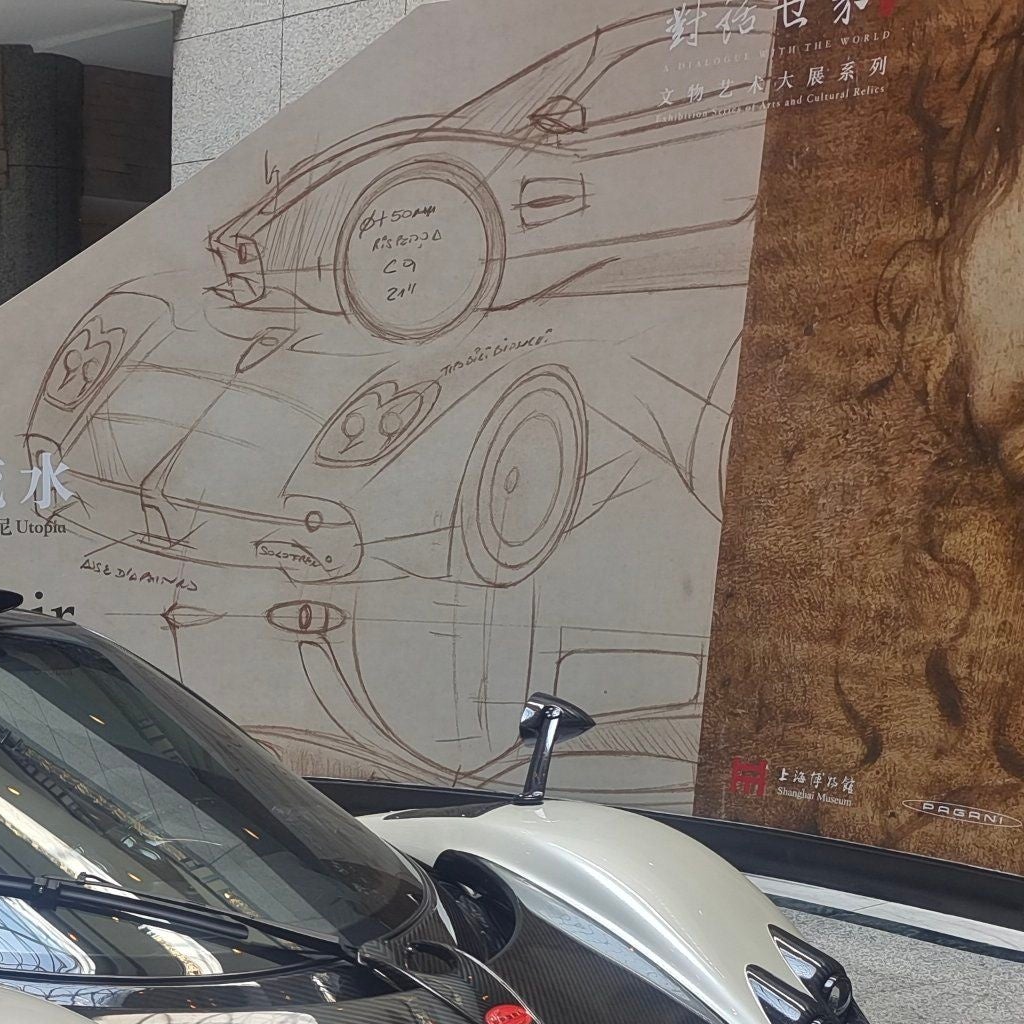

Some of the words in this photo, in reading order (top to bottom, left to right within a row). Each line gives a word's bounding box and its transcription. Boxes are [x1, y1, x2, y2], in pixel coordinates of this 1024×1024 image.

[805, 39, 832, 52] THE
[840, 30, 891, 46] WORLD
[657, 56, 887, 107] 文物艺术大展系列
[655, 108, 708, 123] Exhibition
[761, 99, 781, 111] Arts
[784, 95, 804, 107] and
[807, 89, 849, 103] Cultural
[852, 85, 885, 98] Relics
[16, 519, 67, 537] Utopia
[777, 786, 814, 800] Shanghai
[817, 792, 852, 806] Museum
[922, 802, 1003, 825] PAGANI
